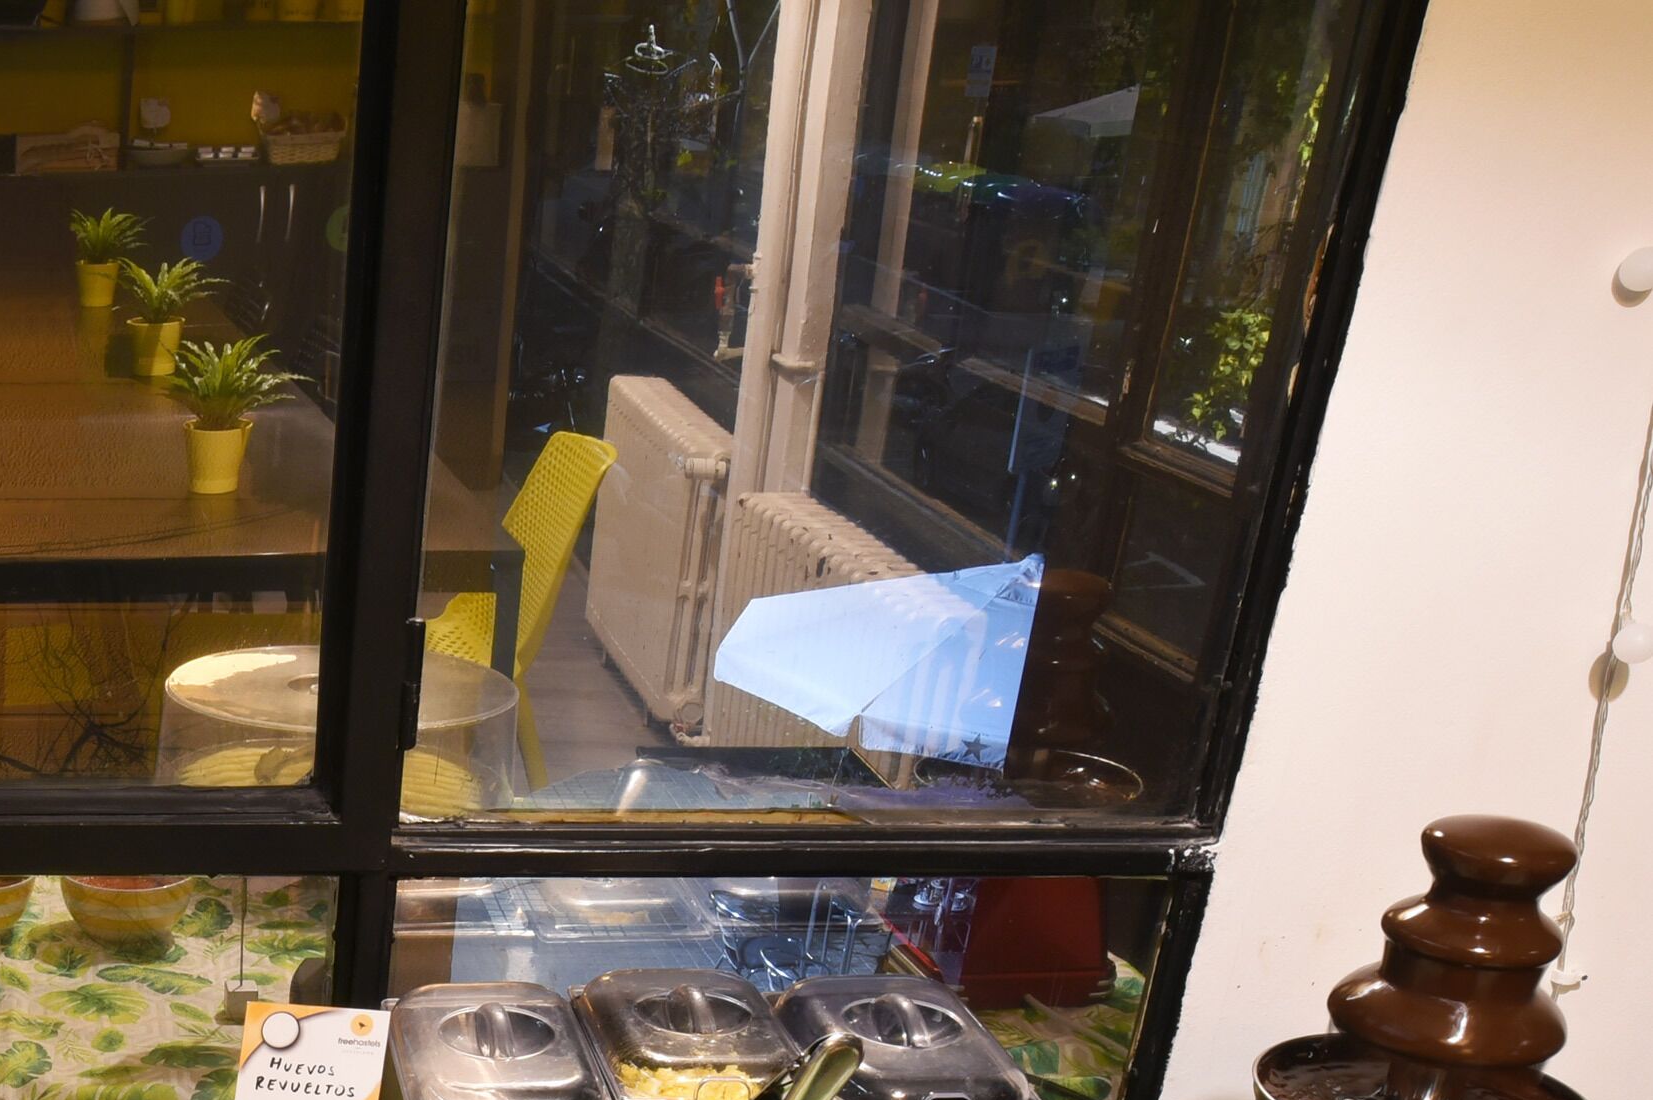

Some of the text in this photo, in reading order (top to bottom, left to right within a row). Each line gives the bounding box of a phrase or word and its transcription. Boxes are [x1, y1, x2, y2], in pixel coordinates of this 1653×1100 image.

[338, 1037, 381, 1048] freehostels
[270, 1057, 336, 1076] HUEVOS
[255, 1075, 355, 1098] REVUELTOS
